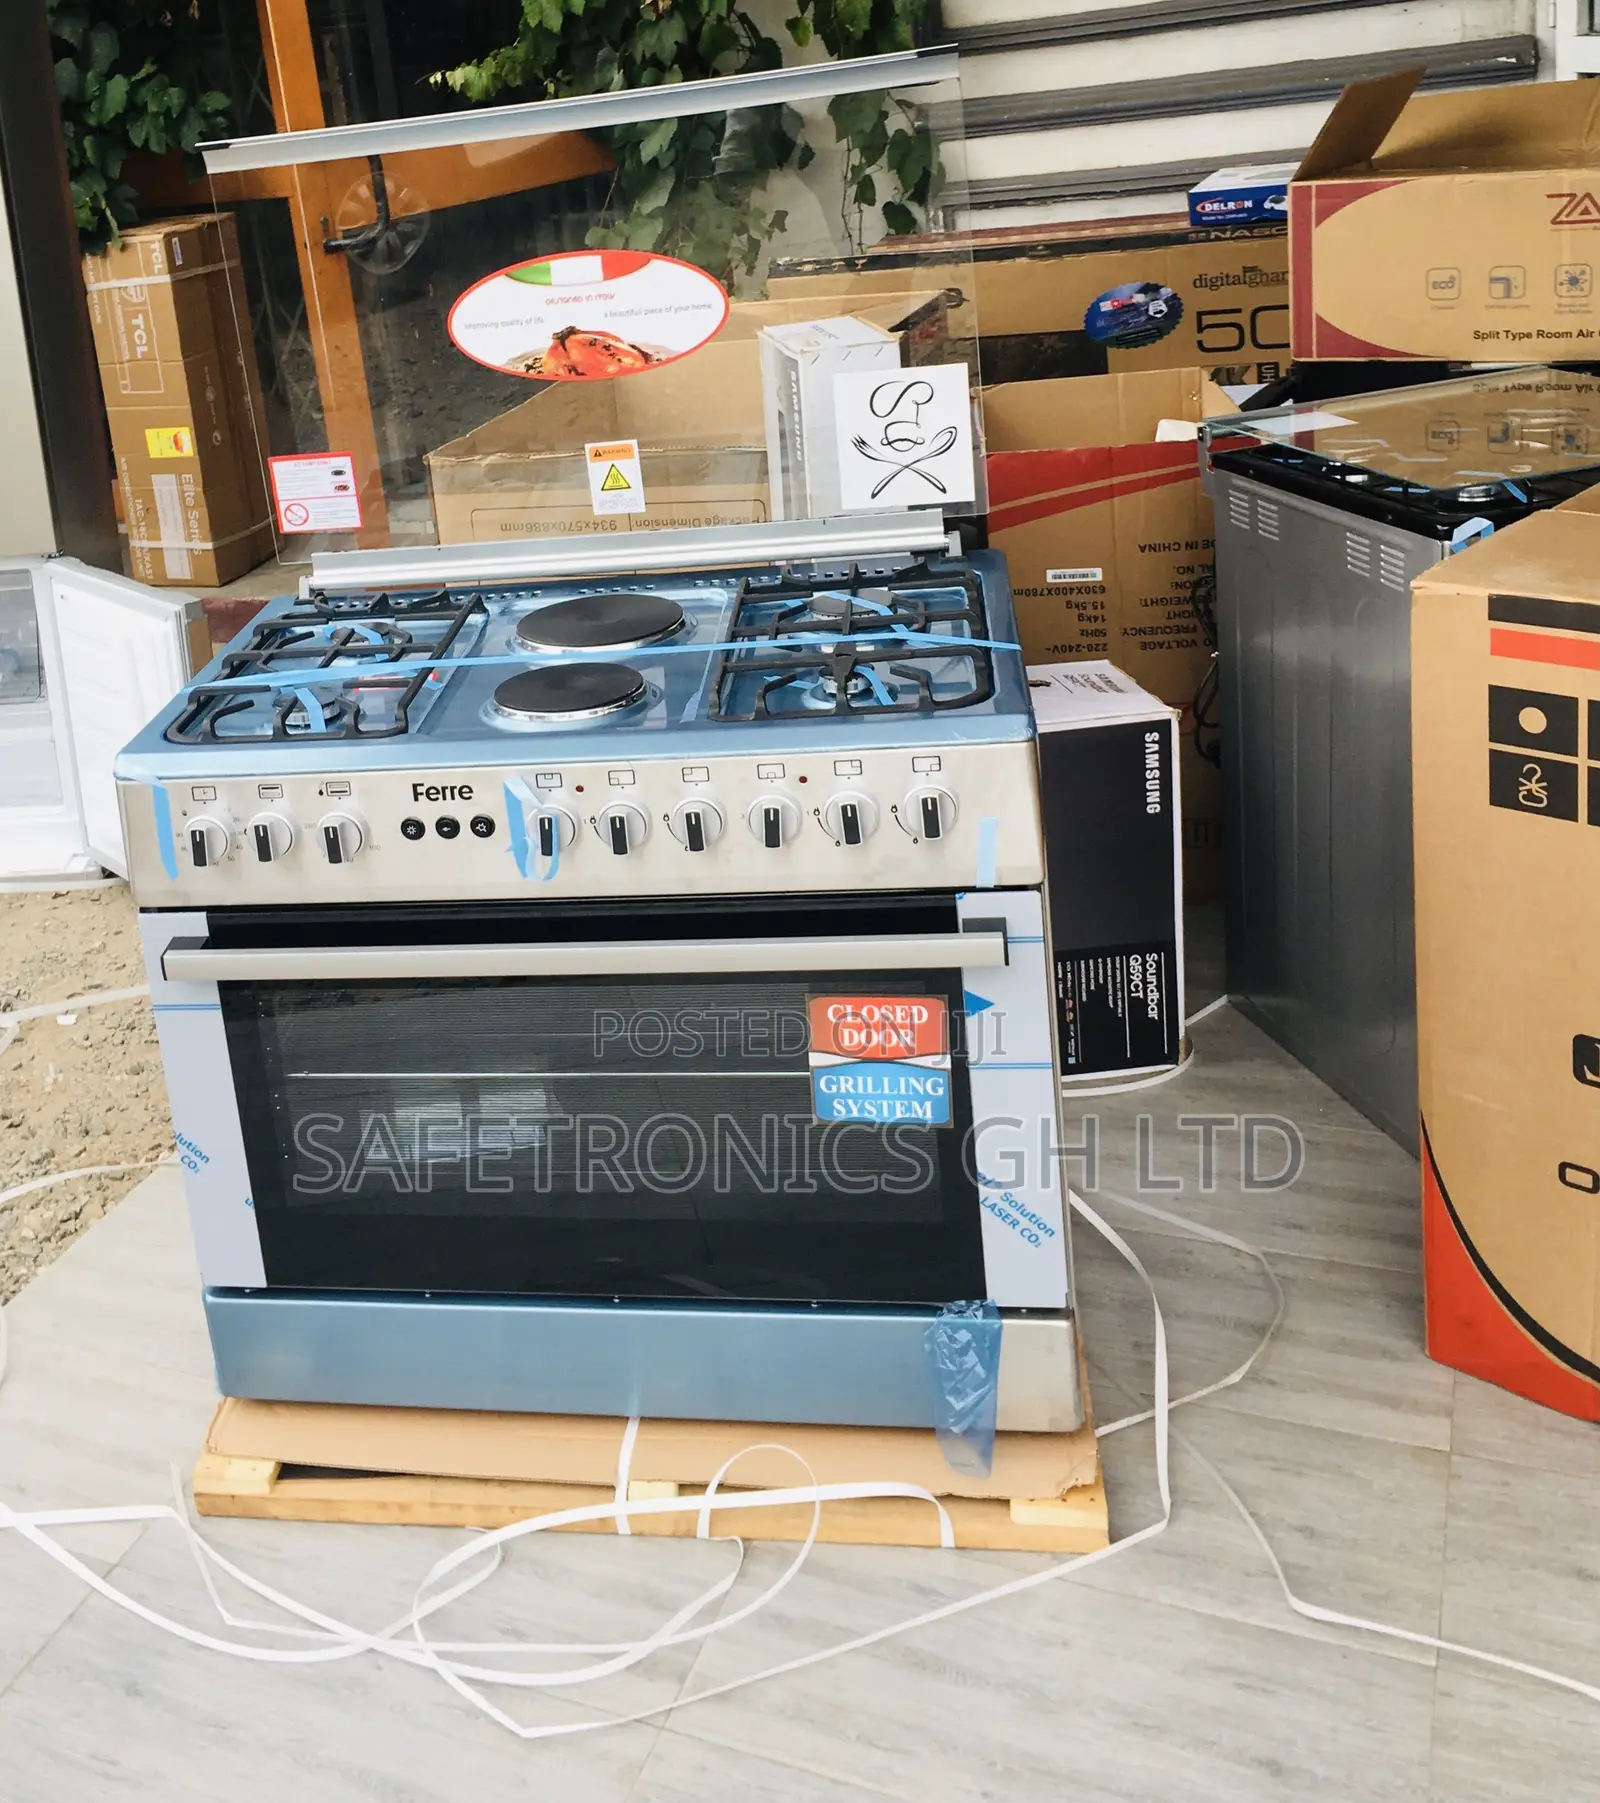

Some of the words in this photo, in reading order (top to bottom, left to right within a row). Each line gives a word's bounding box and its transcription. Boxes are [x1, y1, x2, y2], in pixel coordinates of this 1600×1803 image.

[1205, 200, 1253, 211] DELRON
[150, 241, 163, 274] TCL
[525, 316, 532, 324] of
[665, 305, 672, 313] of
[674, 306, 690, 315] your
[132, 313, 148, 358] TCL
[1196, 304, 1289, 353] 50
[1473, 330, 1500, 341] Split
[1503, 329, 1533, 341] Type
[1536, 329, 1573, 339] Room
[1576, 328, 1595, 339] Air
[790, 370, 802, 462] SAMSUNG
[181, 474, 195, 506] Elite
[500, 519, 617, 532] 934x570x886mm
[1138, 542, 1182, 554] CHINA
[1184, 541, 1199, 551] IN
[1065, 600, 1105, 611] 15.5kg
[1076, 612, 1106, 623] 14kg
[1079, 628, 1107, 638] 50Hz
[1122, 624, 1197, 637] FREQUENCY
[1140, 639, 1198, 651] VOLTAGE
[1144, 731, 1161, 814] SAMSUNG
[411, 782, 475, 802] Ferre
[1129, 954, 1144, 999] Q59CT
[1145, 952, 1160, 1020] Soundbar
[827, 1003, 929, 1025] CLOSED
[841, 1025, 916, 1049] DOOR
[819, 1074, 945, 1098] GRILLING
[832, 1098, 933, 1121] SYSTEM
[980, 1196, 1020, 1230] LASER
[1000, 1191, 1056, 1238] Solution
